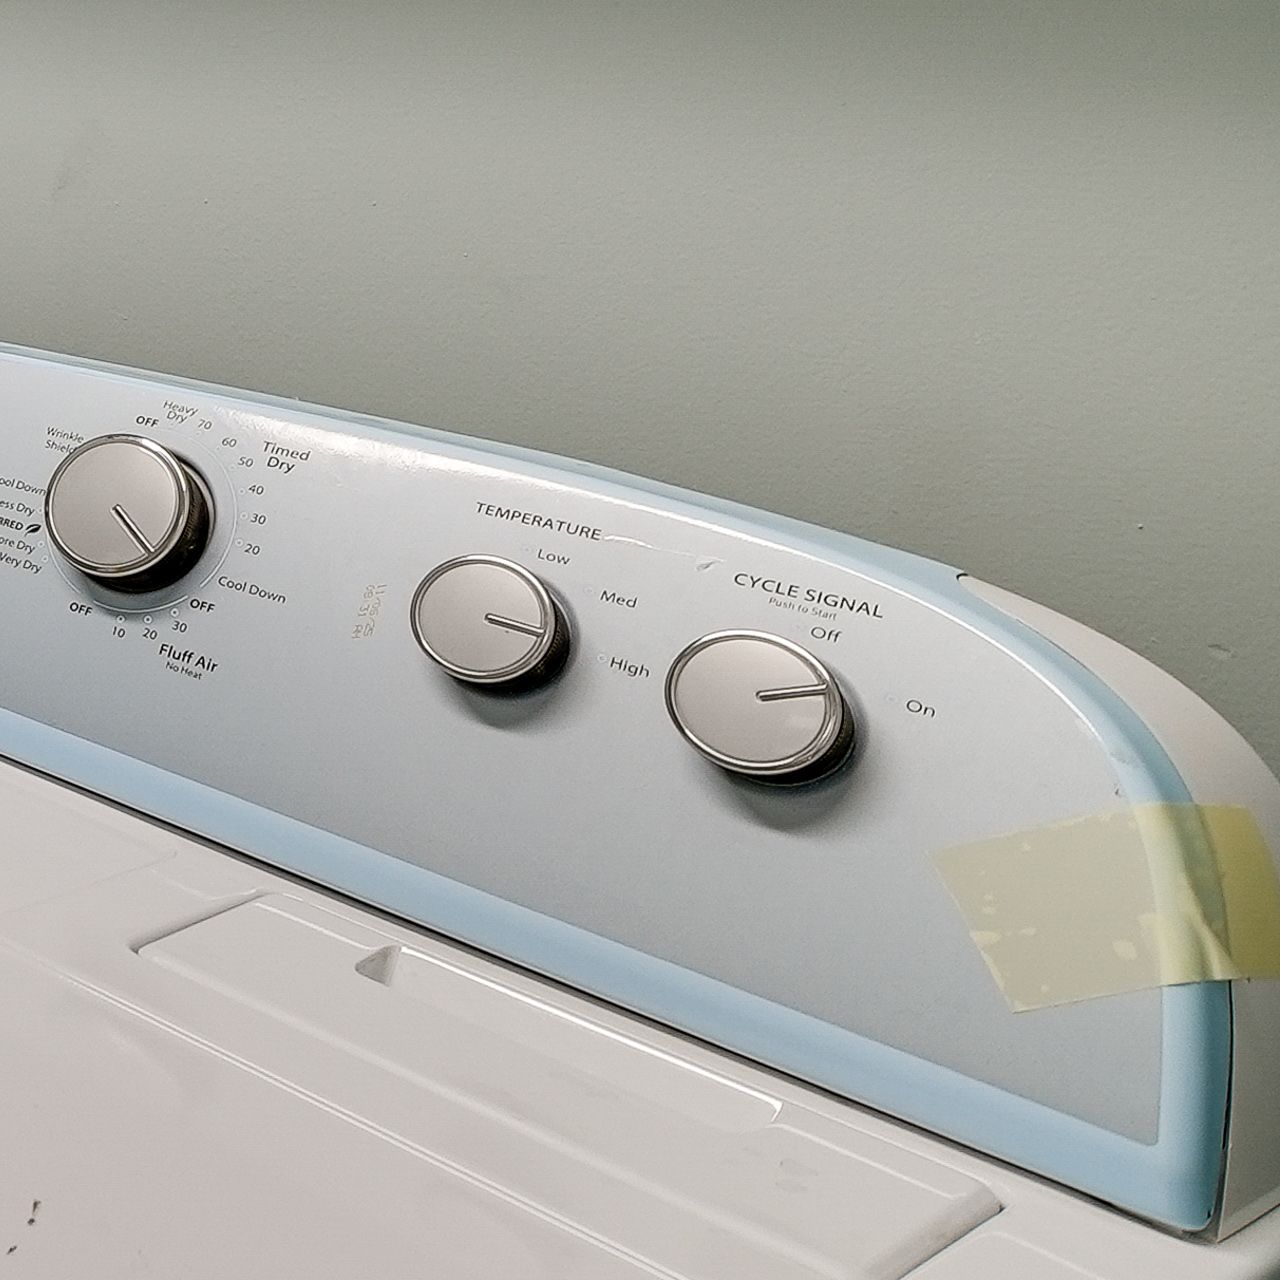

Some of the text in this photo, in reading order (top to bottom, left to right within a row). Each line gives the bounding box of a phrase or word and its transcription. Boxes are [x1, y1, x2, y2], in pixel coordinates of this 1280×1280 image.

[163, 400, 199, 416] Heavy
[135, 416, 160, 428] OFF
[166, 410, 188, 424] Dry
[198, 419, 213, 430] 70
[46, 426, 85, 444] Wrinkle
[221, 437, 237, 448] 60
[262, 440, 312, 462] Timed
[238, 456, 254, 468] 50
[266, 456, 296, 474] Dry
[15, 481, 47, 497] Down
[248, 484, 265, 496] 40
[16, 502, 36, 517] Dry
[250, 513, 267, 526] 30
[476, 501, 603, 541] TEMPERATURE
[16, 539, 36, 555] Dry
[244, 544, 261, 556] 20
[537, 549, 571, 565] Low
[23, 559, 42, 575] Dry
[217, 575, 287, 604] Cool Down
[734, 573, 884, 619] CYCLE SIGNAL
[189, 598, 216, 614] OFF
[600, 590, 638, 608] Med
[69, 601, 93, 616] OFF
[768, 597, 838, 621] Push to Start
[112, 625, 126, 639] 10
[142, 627, 158, 640] 20
[172, 620, 188, 633] 30
[810, 626, 842, 643] Off
[159, 643, 219, 673] Fluff Air
[165, 660, 203, 681] No Heat
[610, 656, 650, 678] High
[905, 699, 936, 718] On
